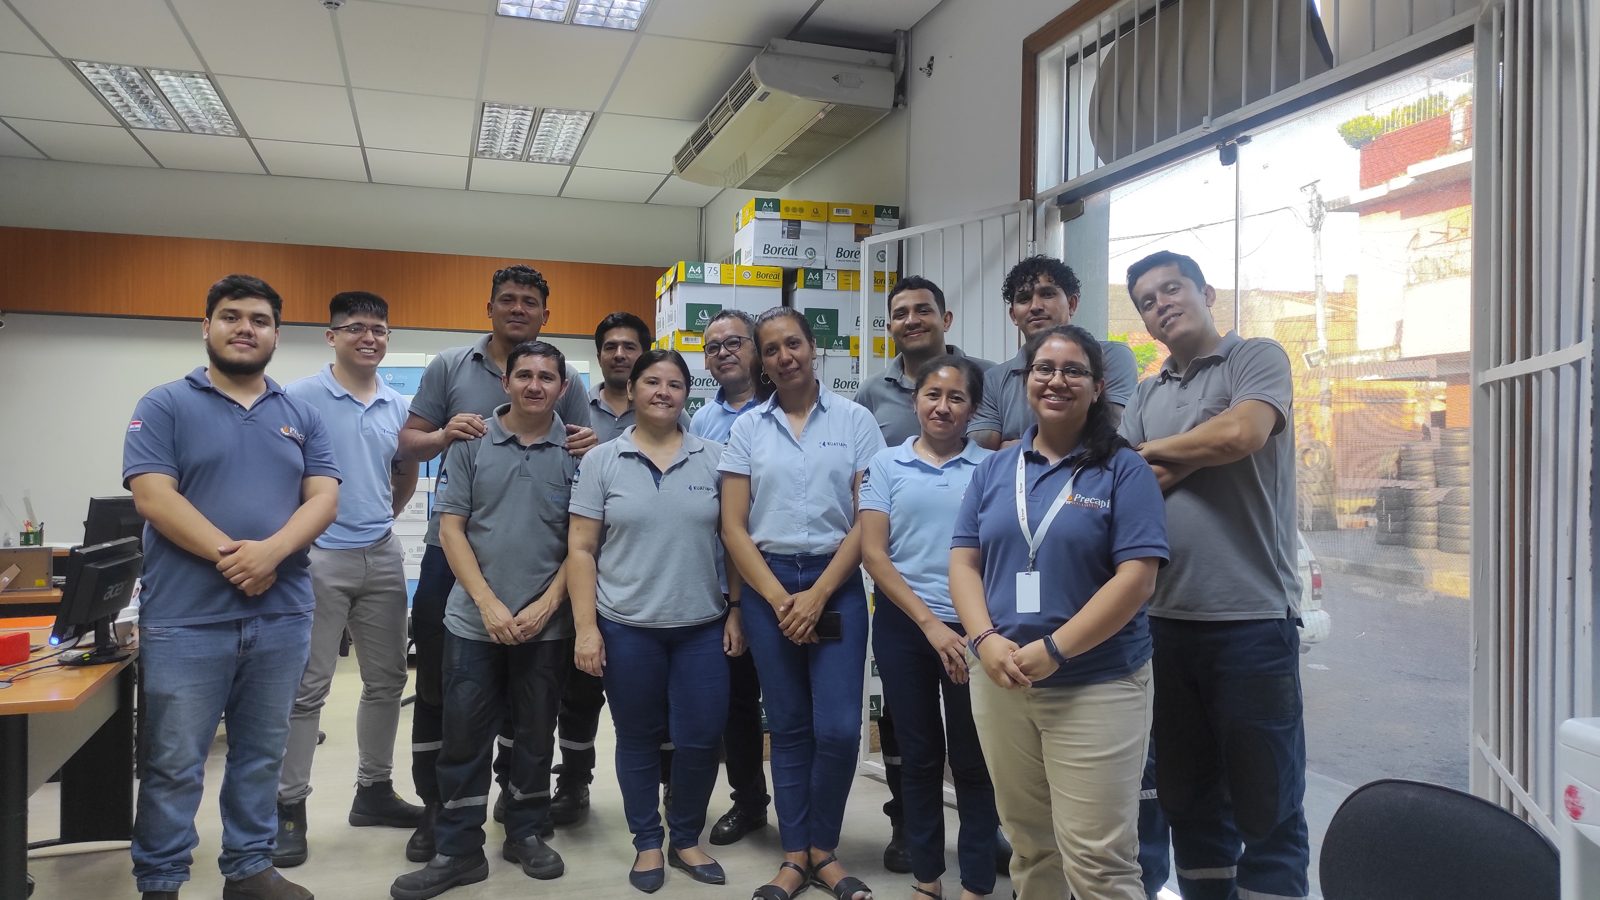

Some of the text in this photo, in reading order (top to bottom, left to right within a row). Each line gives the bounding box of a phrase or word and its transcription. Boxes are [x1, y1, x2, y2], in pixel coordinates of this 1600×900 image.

[762, 243, 798, 257] Boreal
[835, 247, 861, 259] Bore
[688, 265, 702, 274] A4
[707, 266, 719, 274] 75
[755, 271, 780, 281] Boreal
[807, 272, 820, 280] A4
[825, 272, 836, 281] 75
[690, 375, 721, 387] Borea
[832, 377, 860, 390] Bore
[688, 401, 702, 410] A4
[1073, 493, 1111, 509] Precapi
